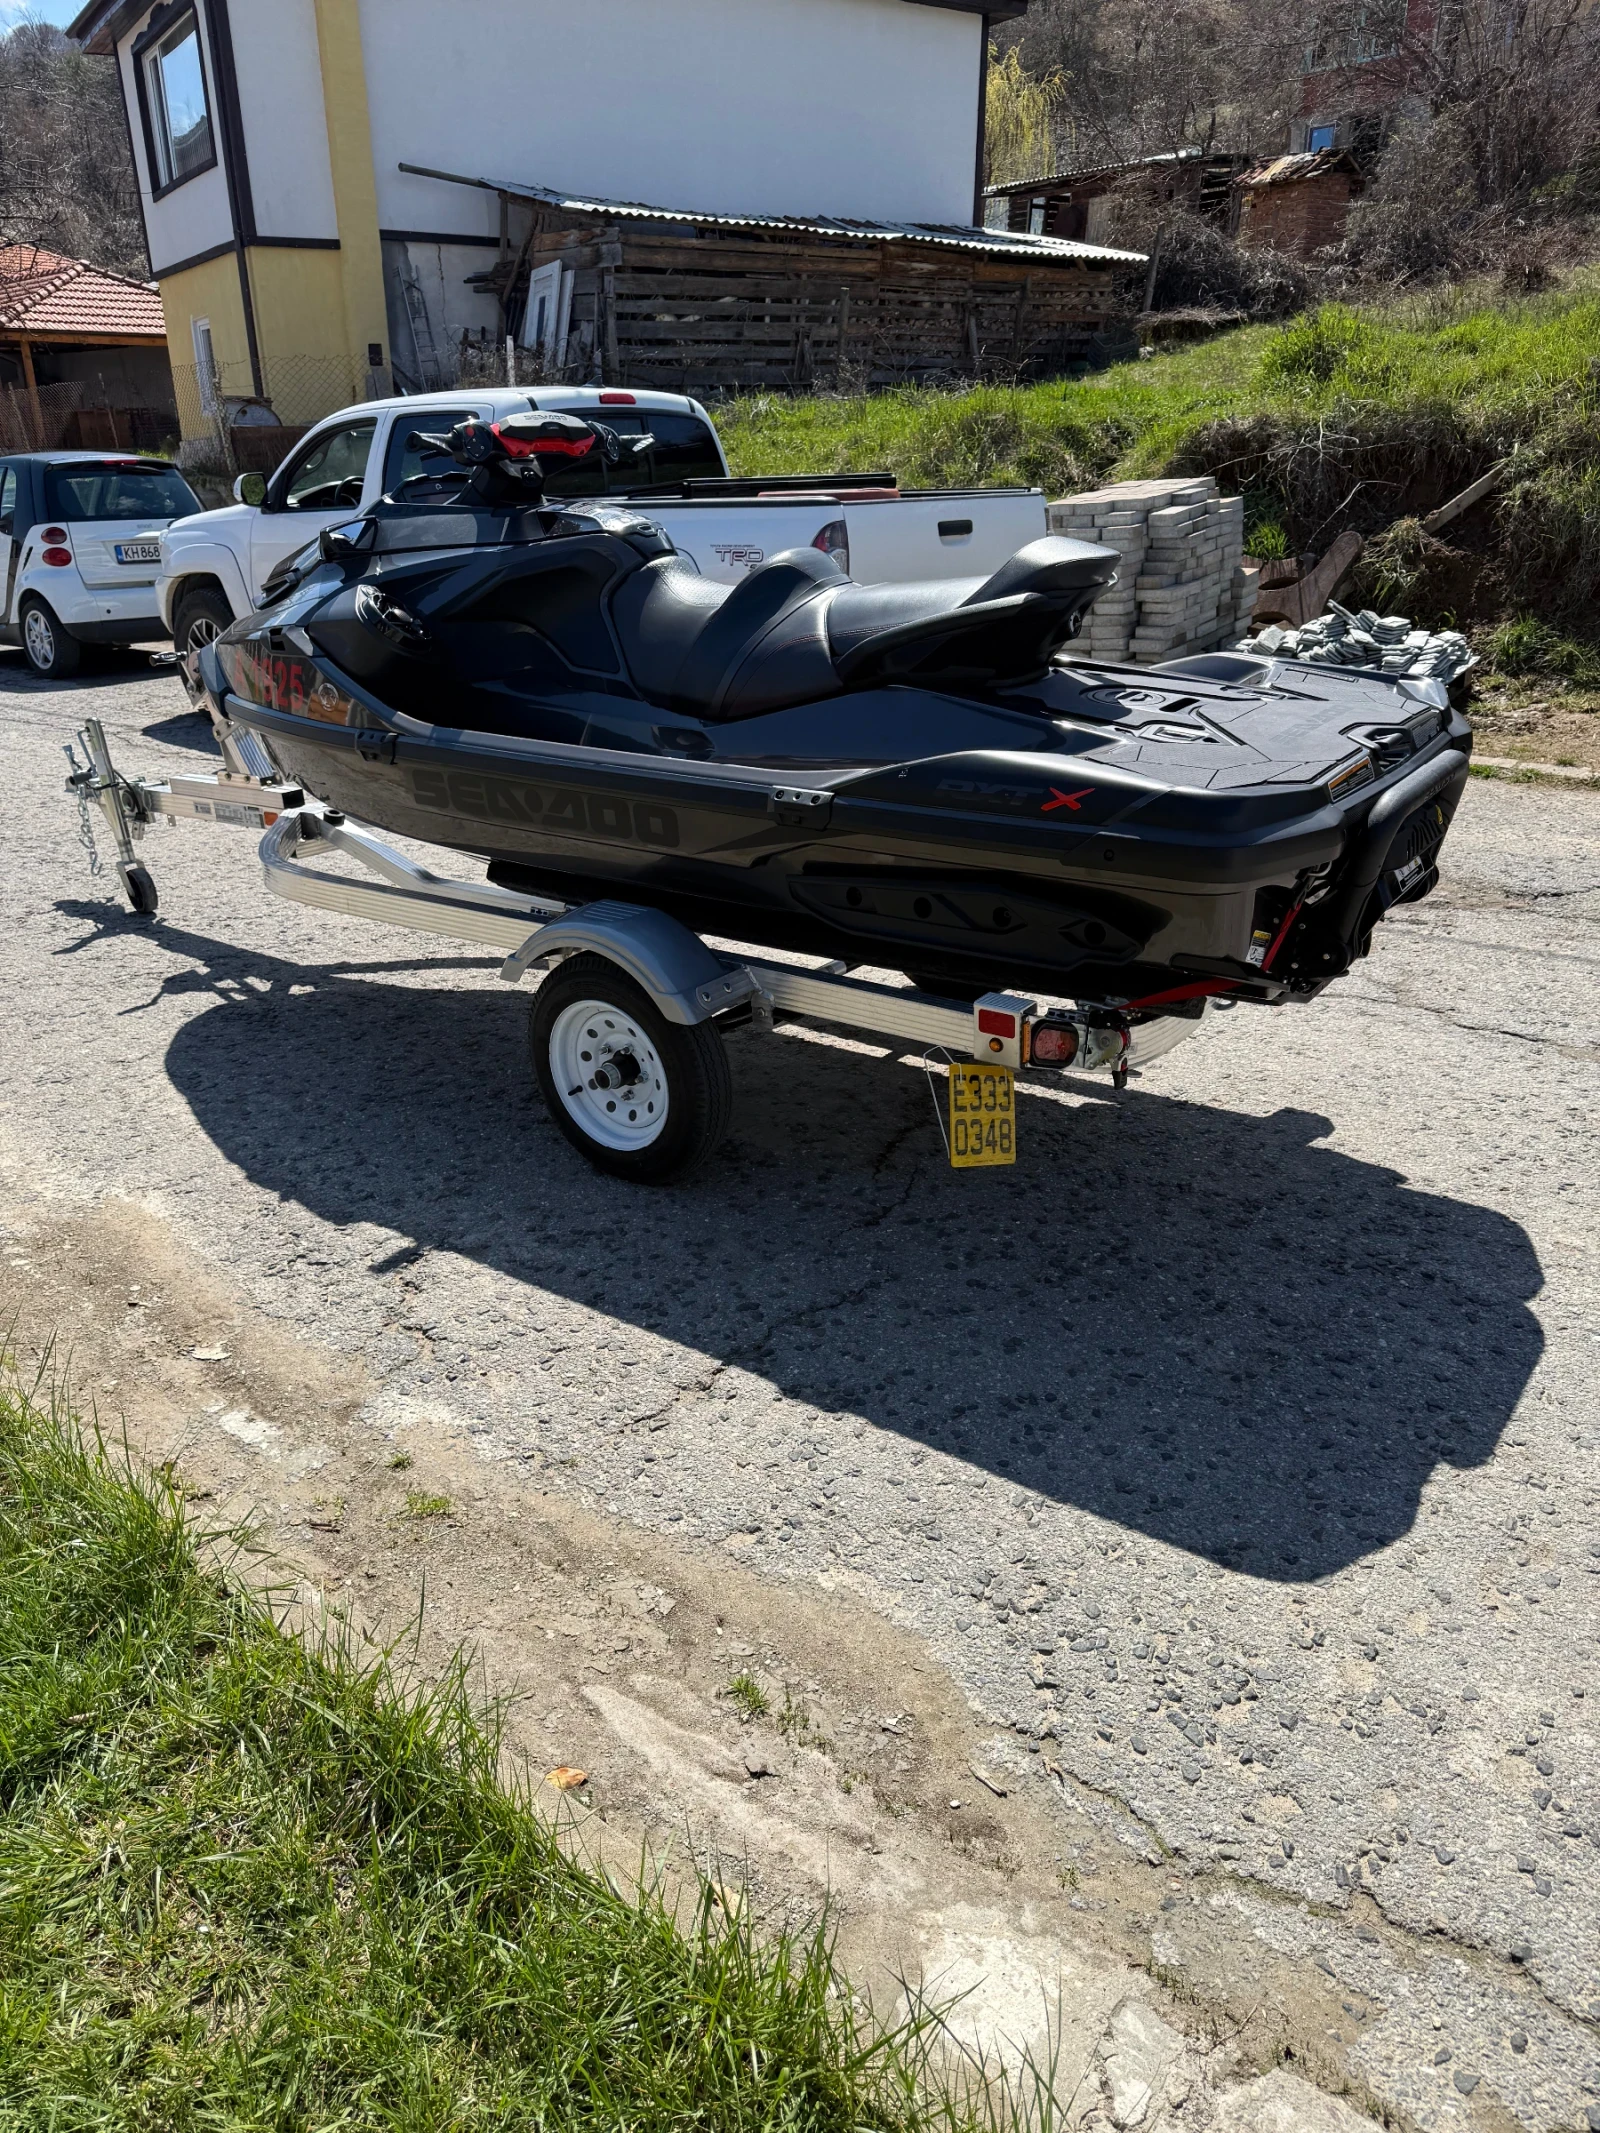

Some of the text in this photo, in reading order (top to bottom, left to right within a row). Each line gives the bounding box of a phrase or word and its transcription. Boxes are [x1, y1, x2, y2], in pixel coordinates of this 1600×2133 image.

[123, 546, 161, 559] KH 868
[715, 548, 764, 567] TRD
[233, 649, 246, 696] A
[250, 655, 304, 710] 1925
[953, 1074, 1011, 1112] E333
[955, 1118, 1012, 1156] 0348
